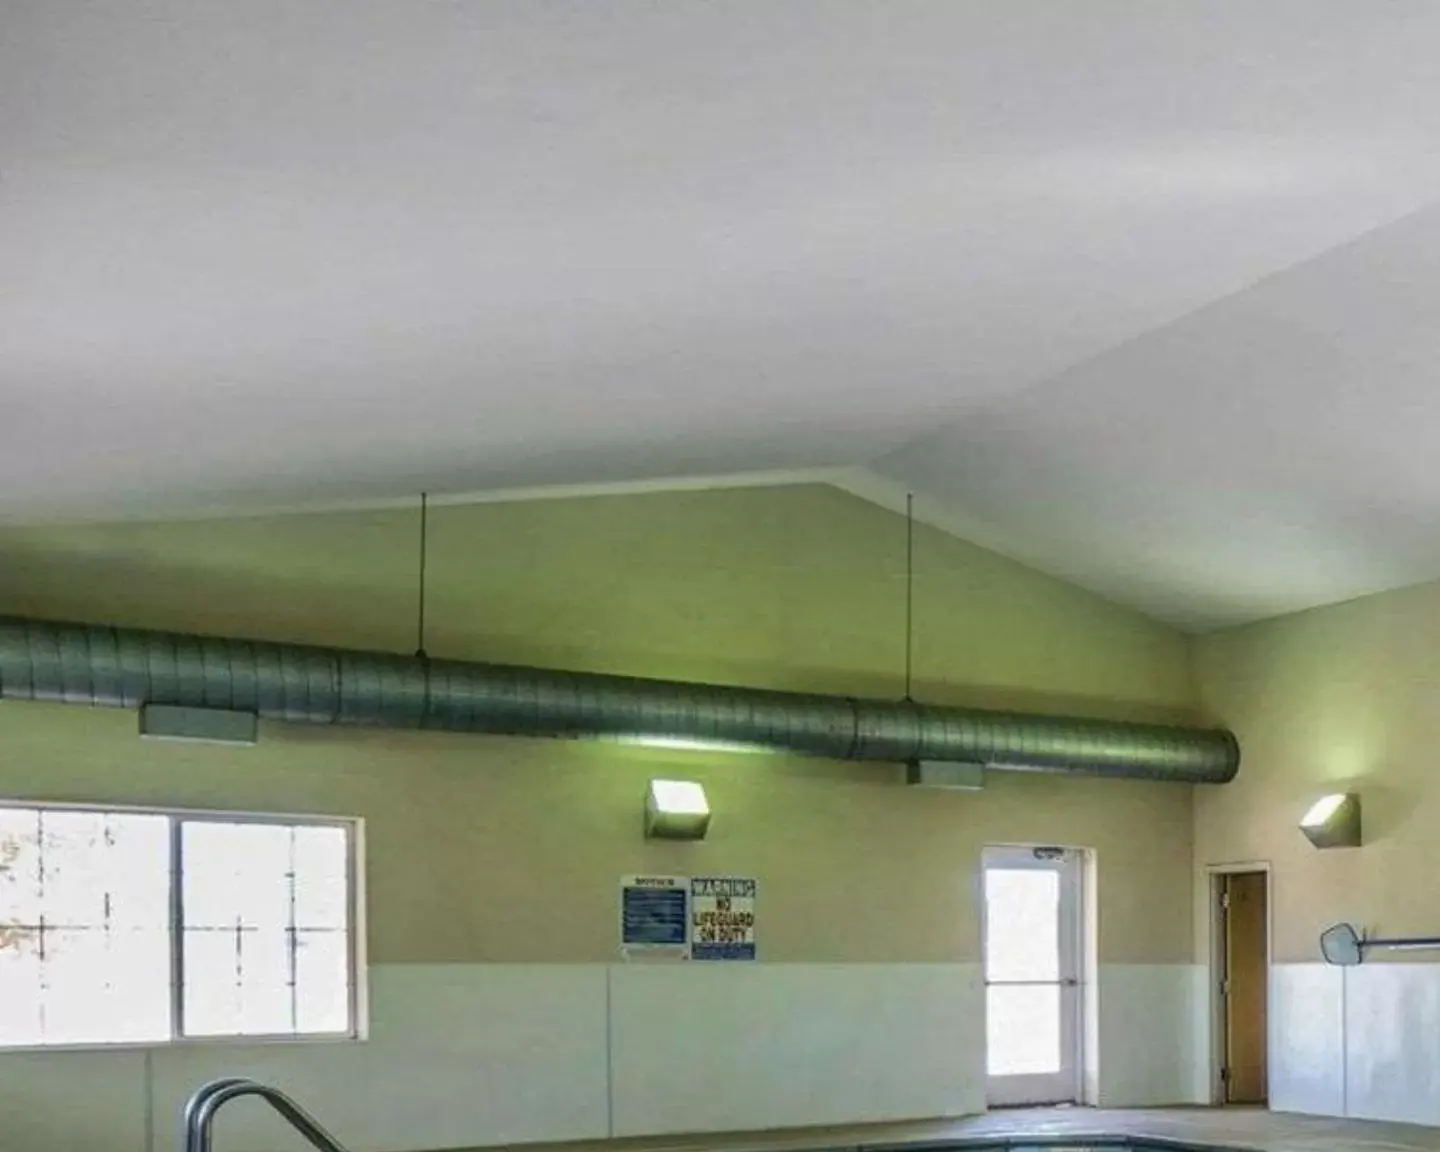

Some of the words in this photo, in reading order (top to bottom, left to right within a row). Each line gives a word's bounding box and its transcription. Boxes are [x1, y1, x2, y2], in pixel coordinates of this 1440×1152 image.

[716, 898, 730, 911] NO
[693, 912, 753, 926] LIFEGUARD
[700, 926, 715, 941] ON
[719, 926, 745, 941] DUTY
